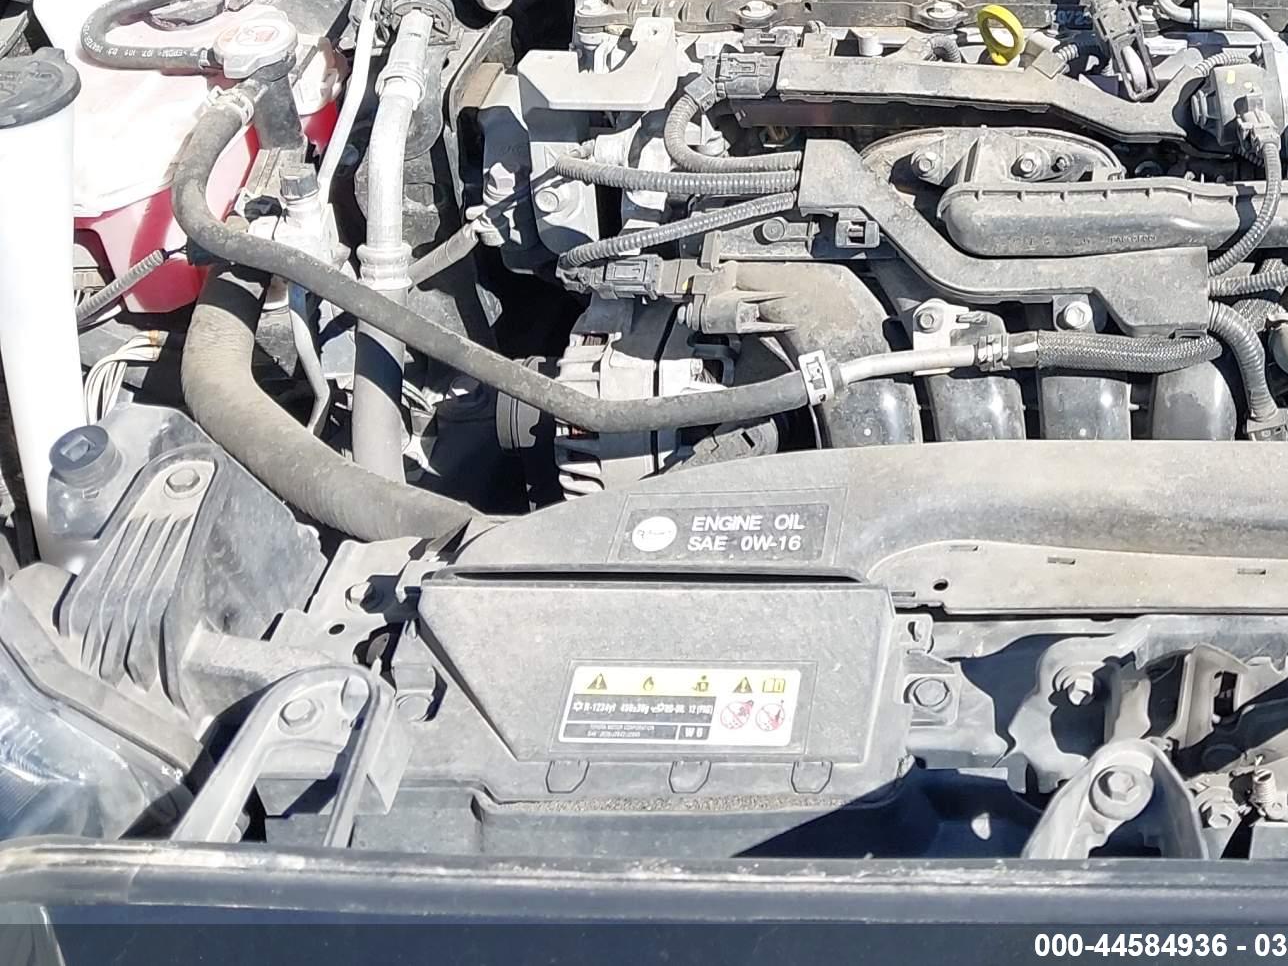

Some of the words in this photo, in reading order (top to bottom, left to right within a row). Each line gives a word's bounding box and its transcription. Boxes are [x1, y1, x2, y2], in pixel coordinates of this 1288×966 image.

[691, 515, 763, 532] ENGINE
[774, 514, 805, 530] OIL
[687, 535, 728, 552] SAE
[740, 534, 802, 551] 0W-16
